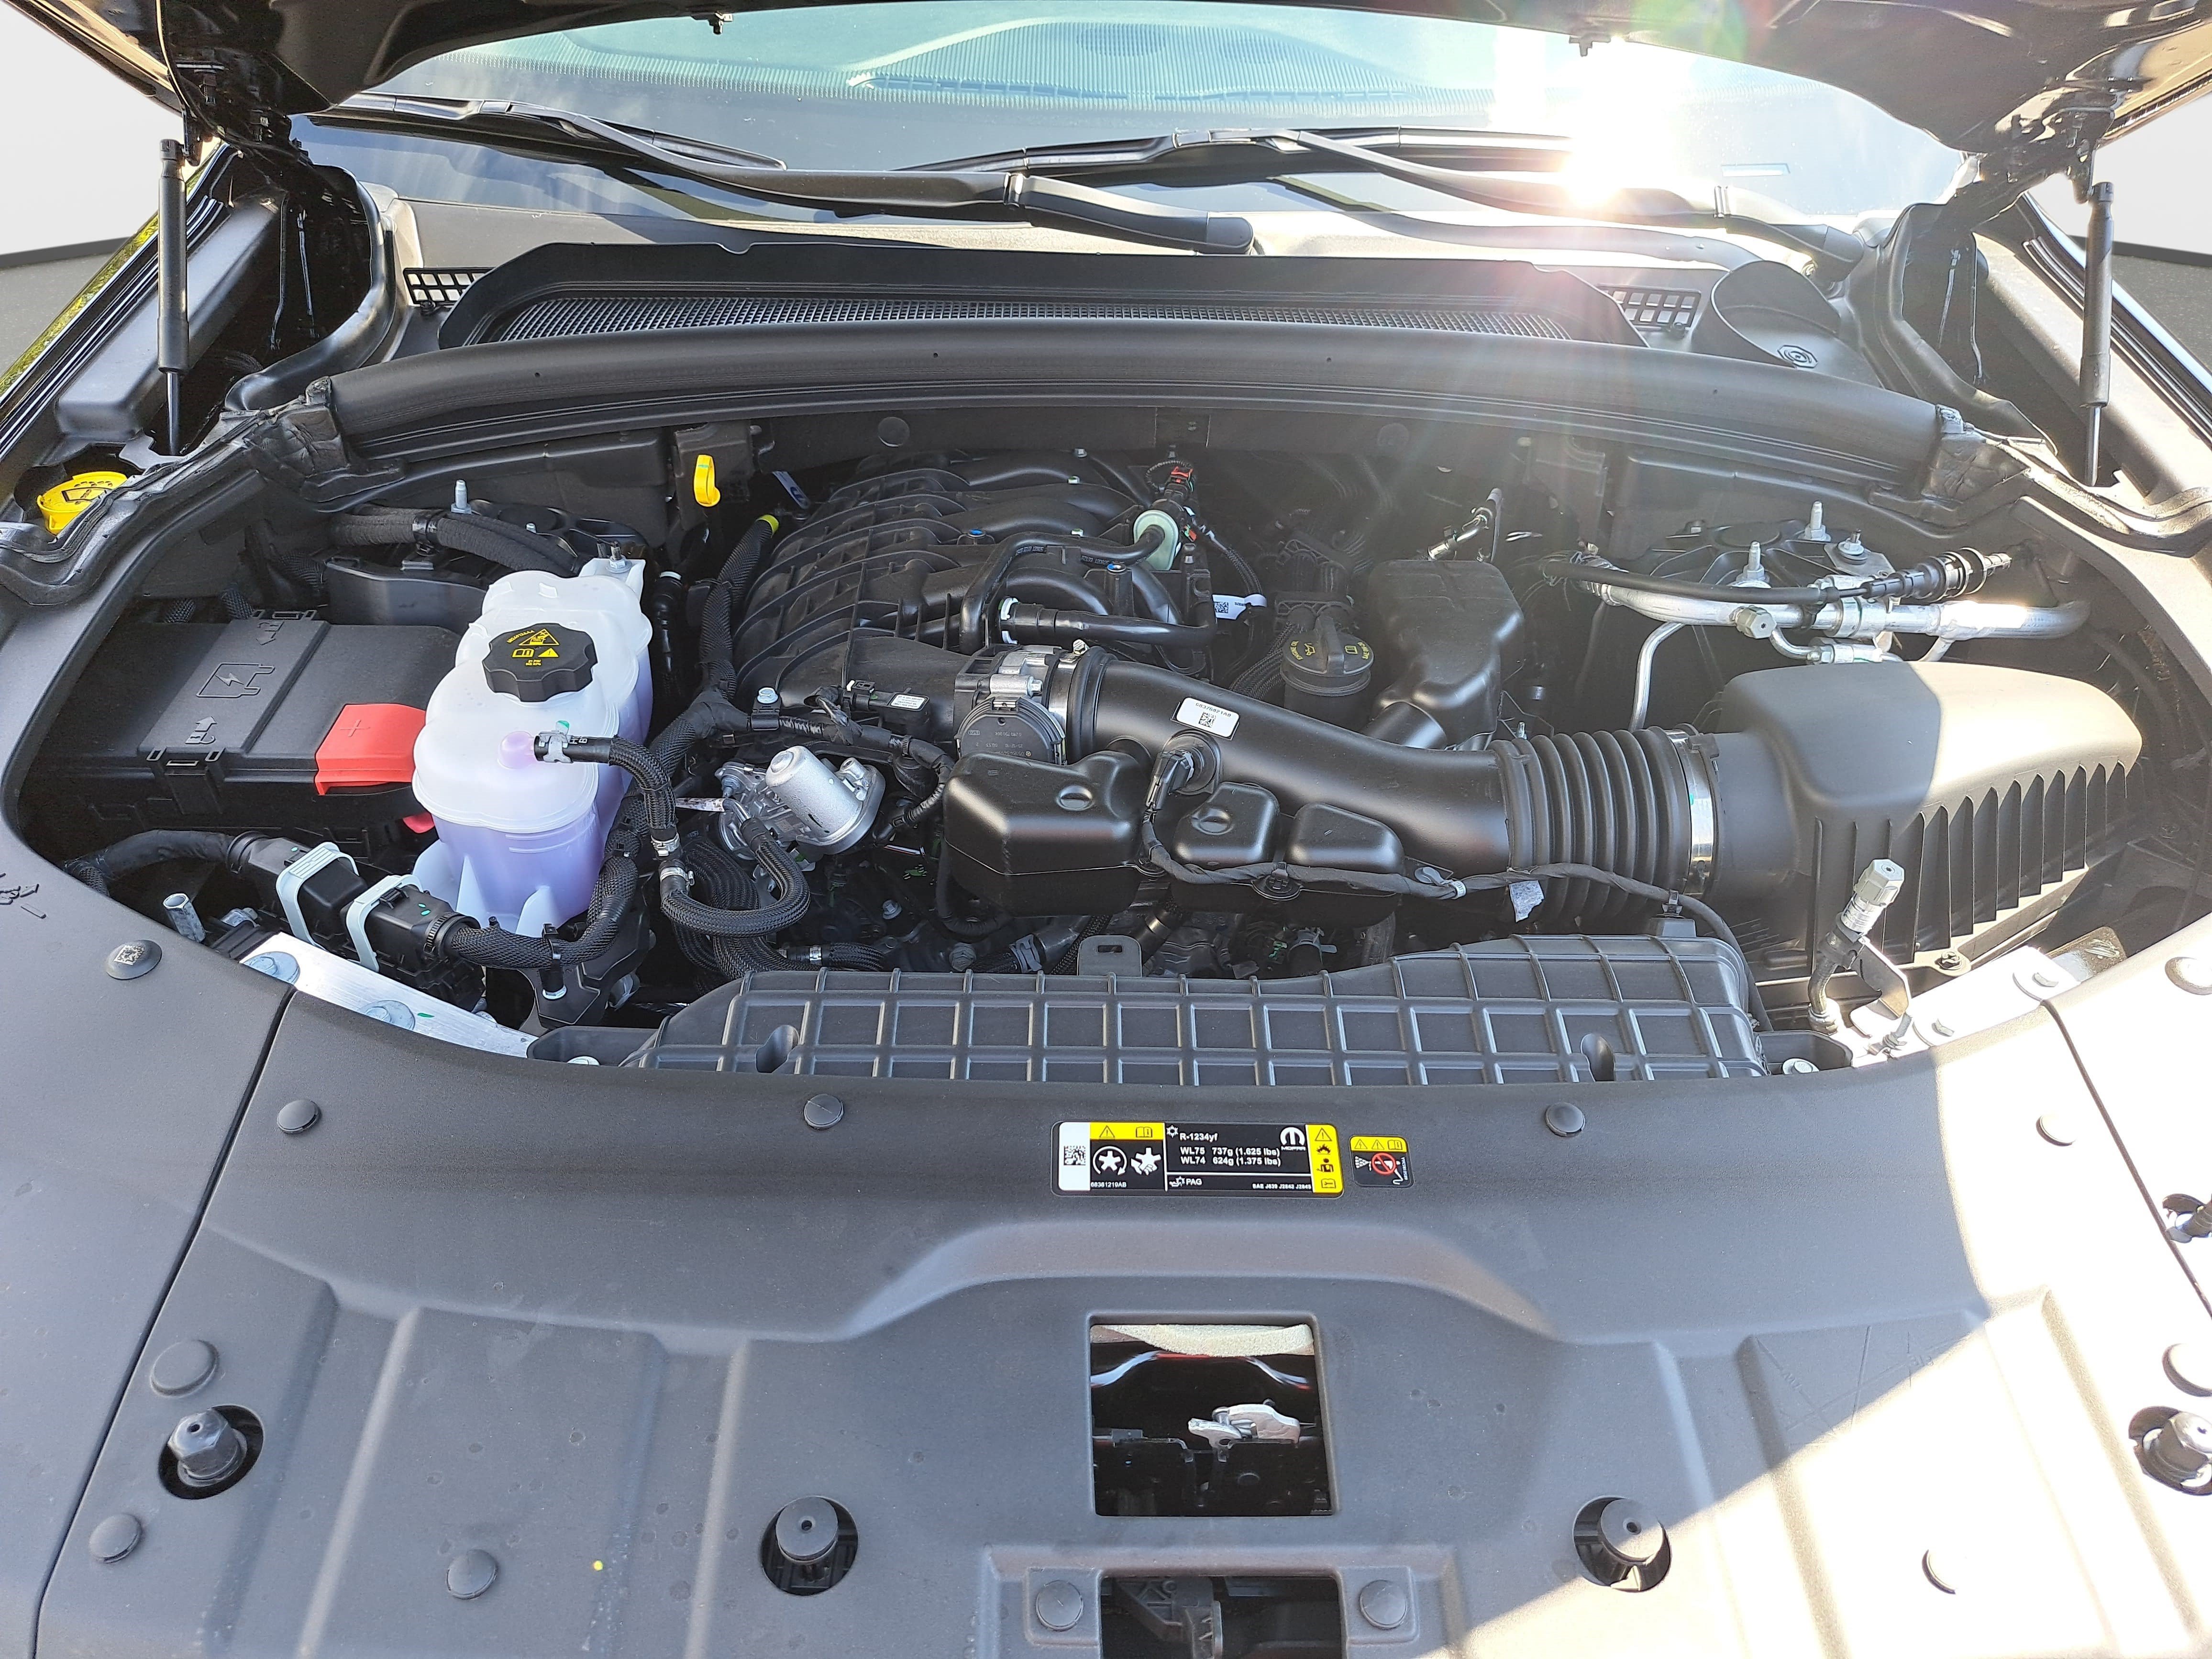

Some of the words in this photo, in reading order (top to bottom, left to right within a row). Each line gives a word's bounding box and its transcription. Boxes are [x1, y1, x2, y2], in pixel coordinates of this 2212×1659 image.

[1180, 1133, 1218, 1142] R-1234yf
[1180, 1147, 1205, 1155] WL75
[1212, 1147, 1233, 1157] 737g
[1236, 1147, 1261, 1157] (1.625
[1263, 1148, 1280, 1158] lbs)
[1181, 1156, 1206, 1164] WL74
[1213, 1157, 1234, 1166] 624g
[1236, 1157, 1262, 1166] (1.375
[1264, 1157, 1281, 1167] lbs)
